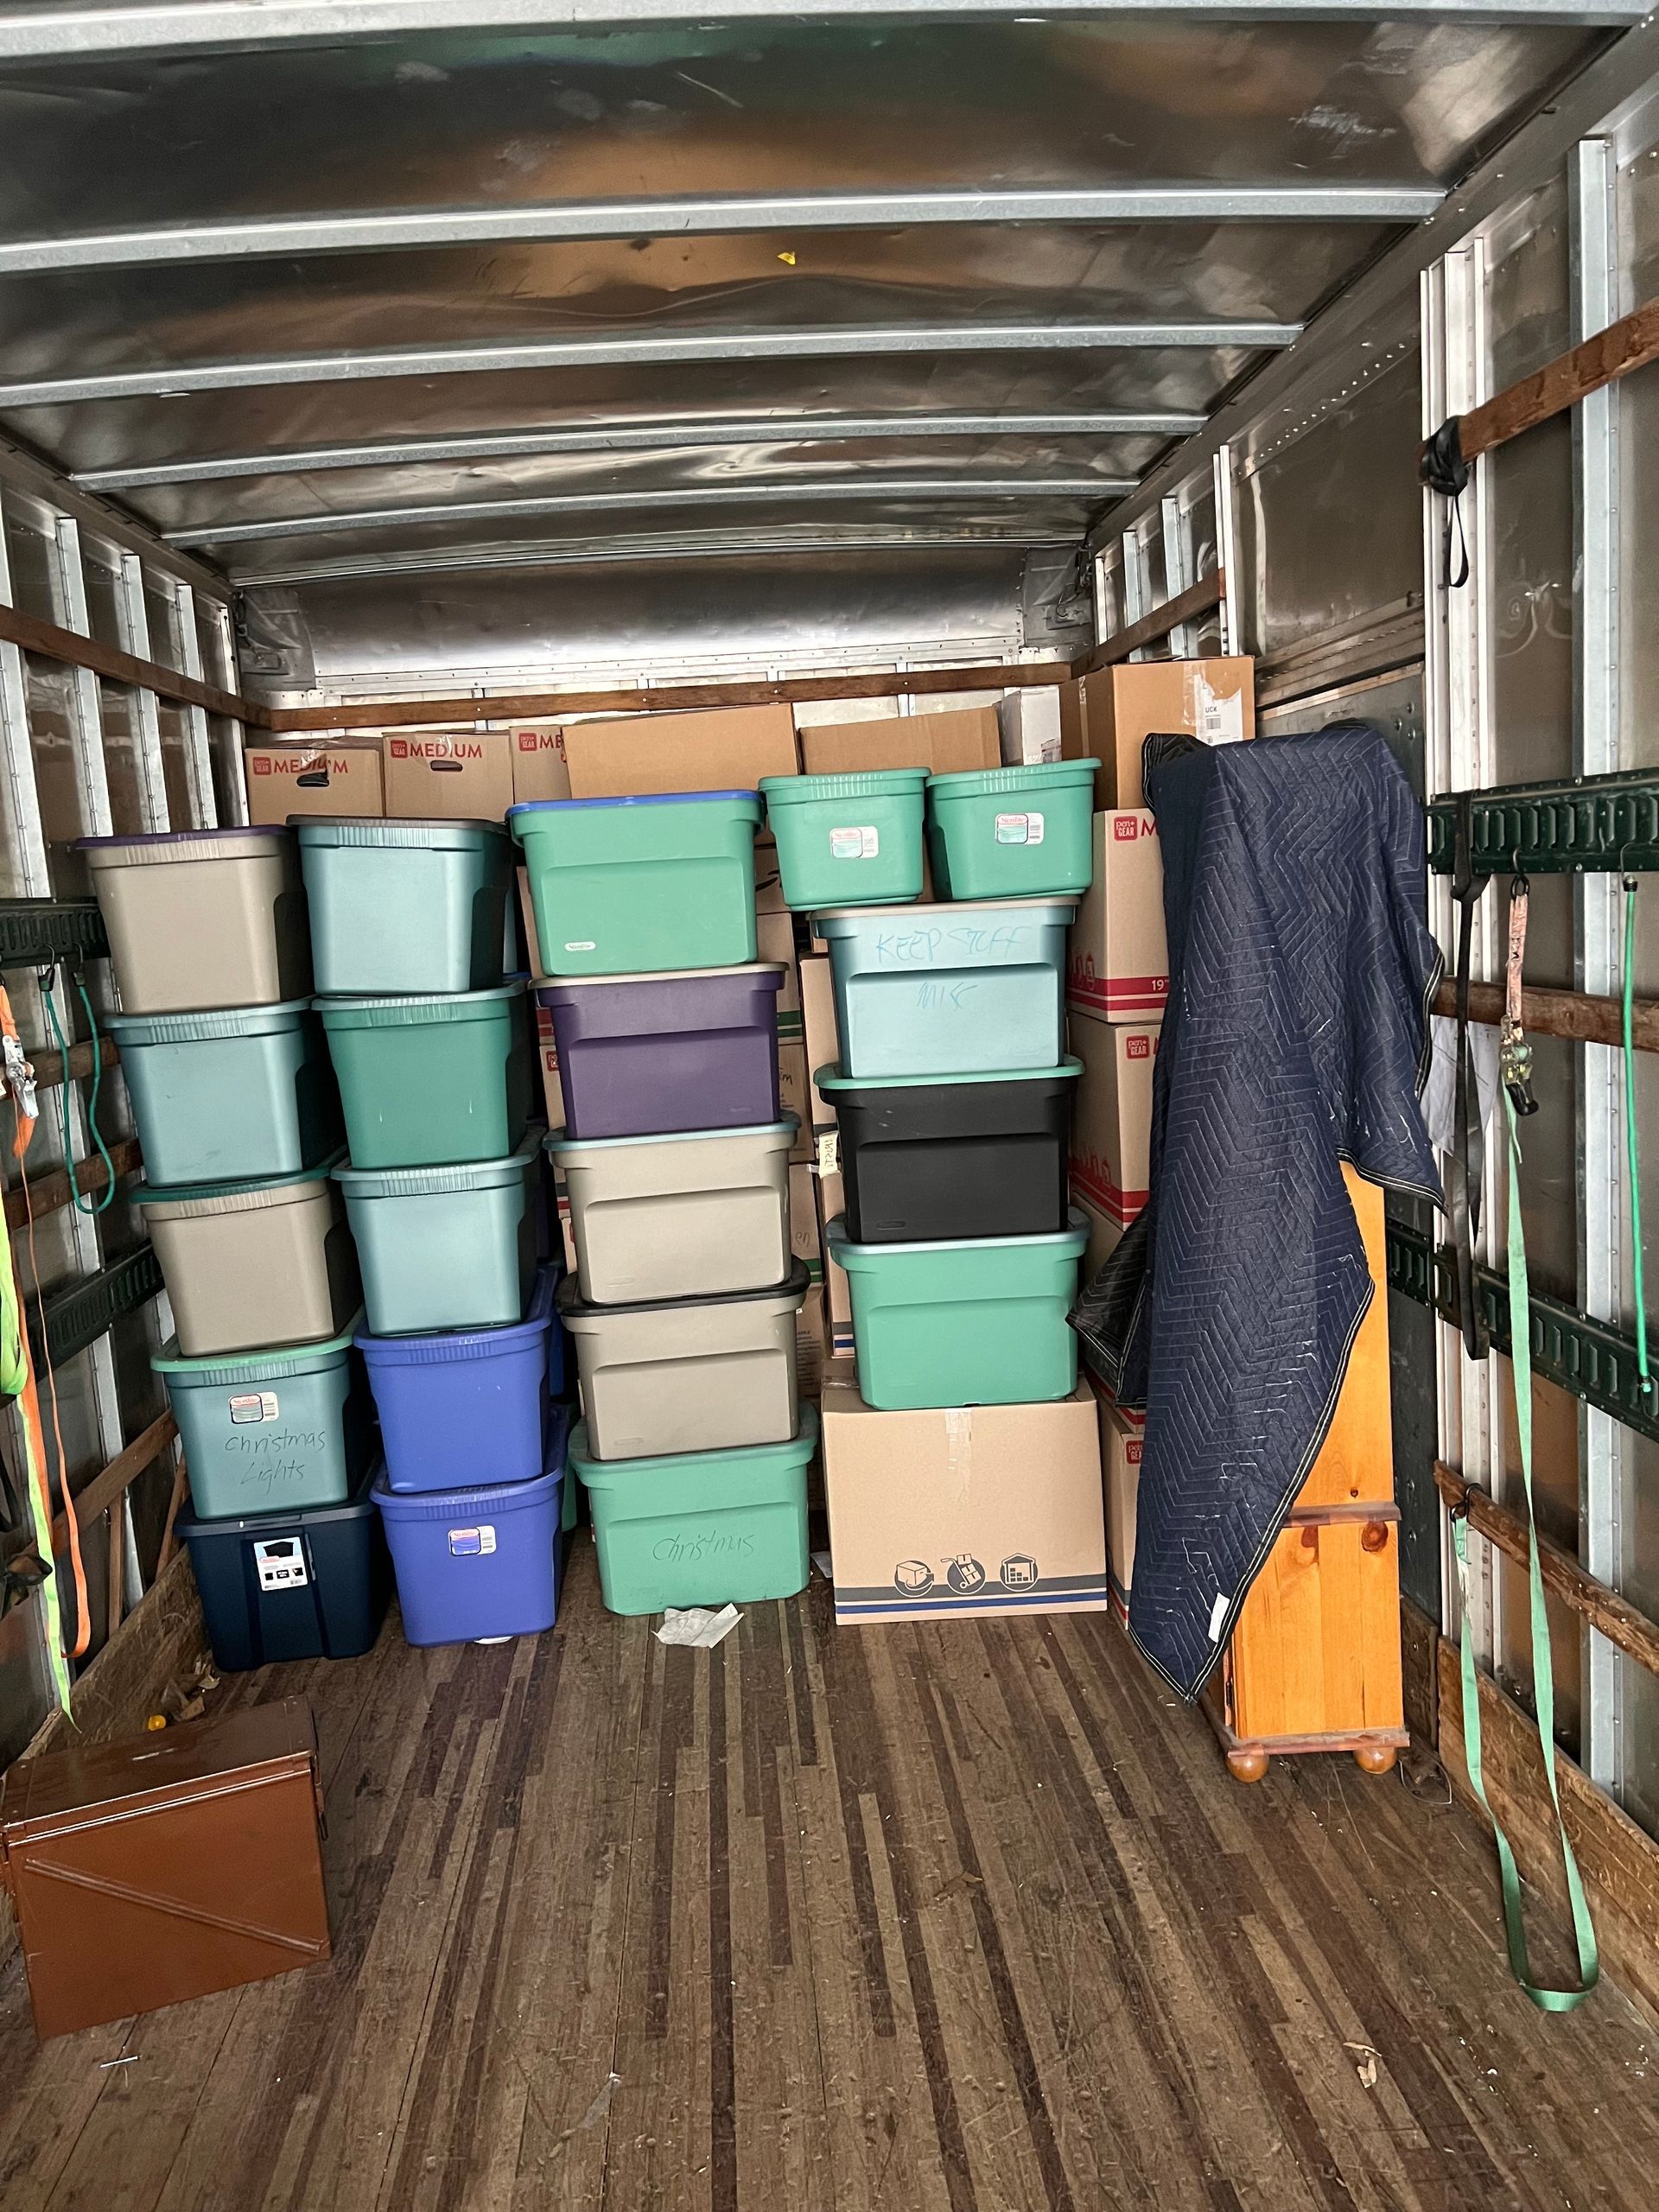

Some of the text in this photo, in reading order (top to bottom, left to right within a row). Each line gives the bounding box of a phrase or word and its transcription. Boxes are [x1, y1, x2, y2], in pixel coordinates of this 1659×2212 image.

[1118, 827, 1135, 837] GEAR
[875, 928, 942, 963] KEEP
[240, 1459, 305, 1495] Lights
